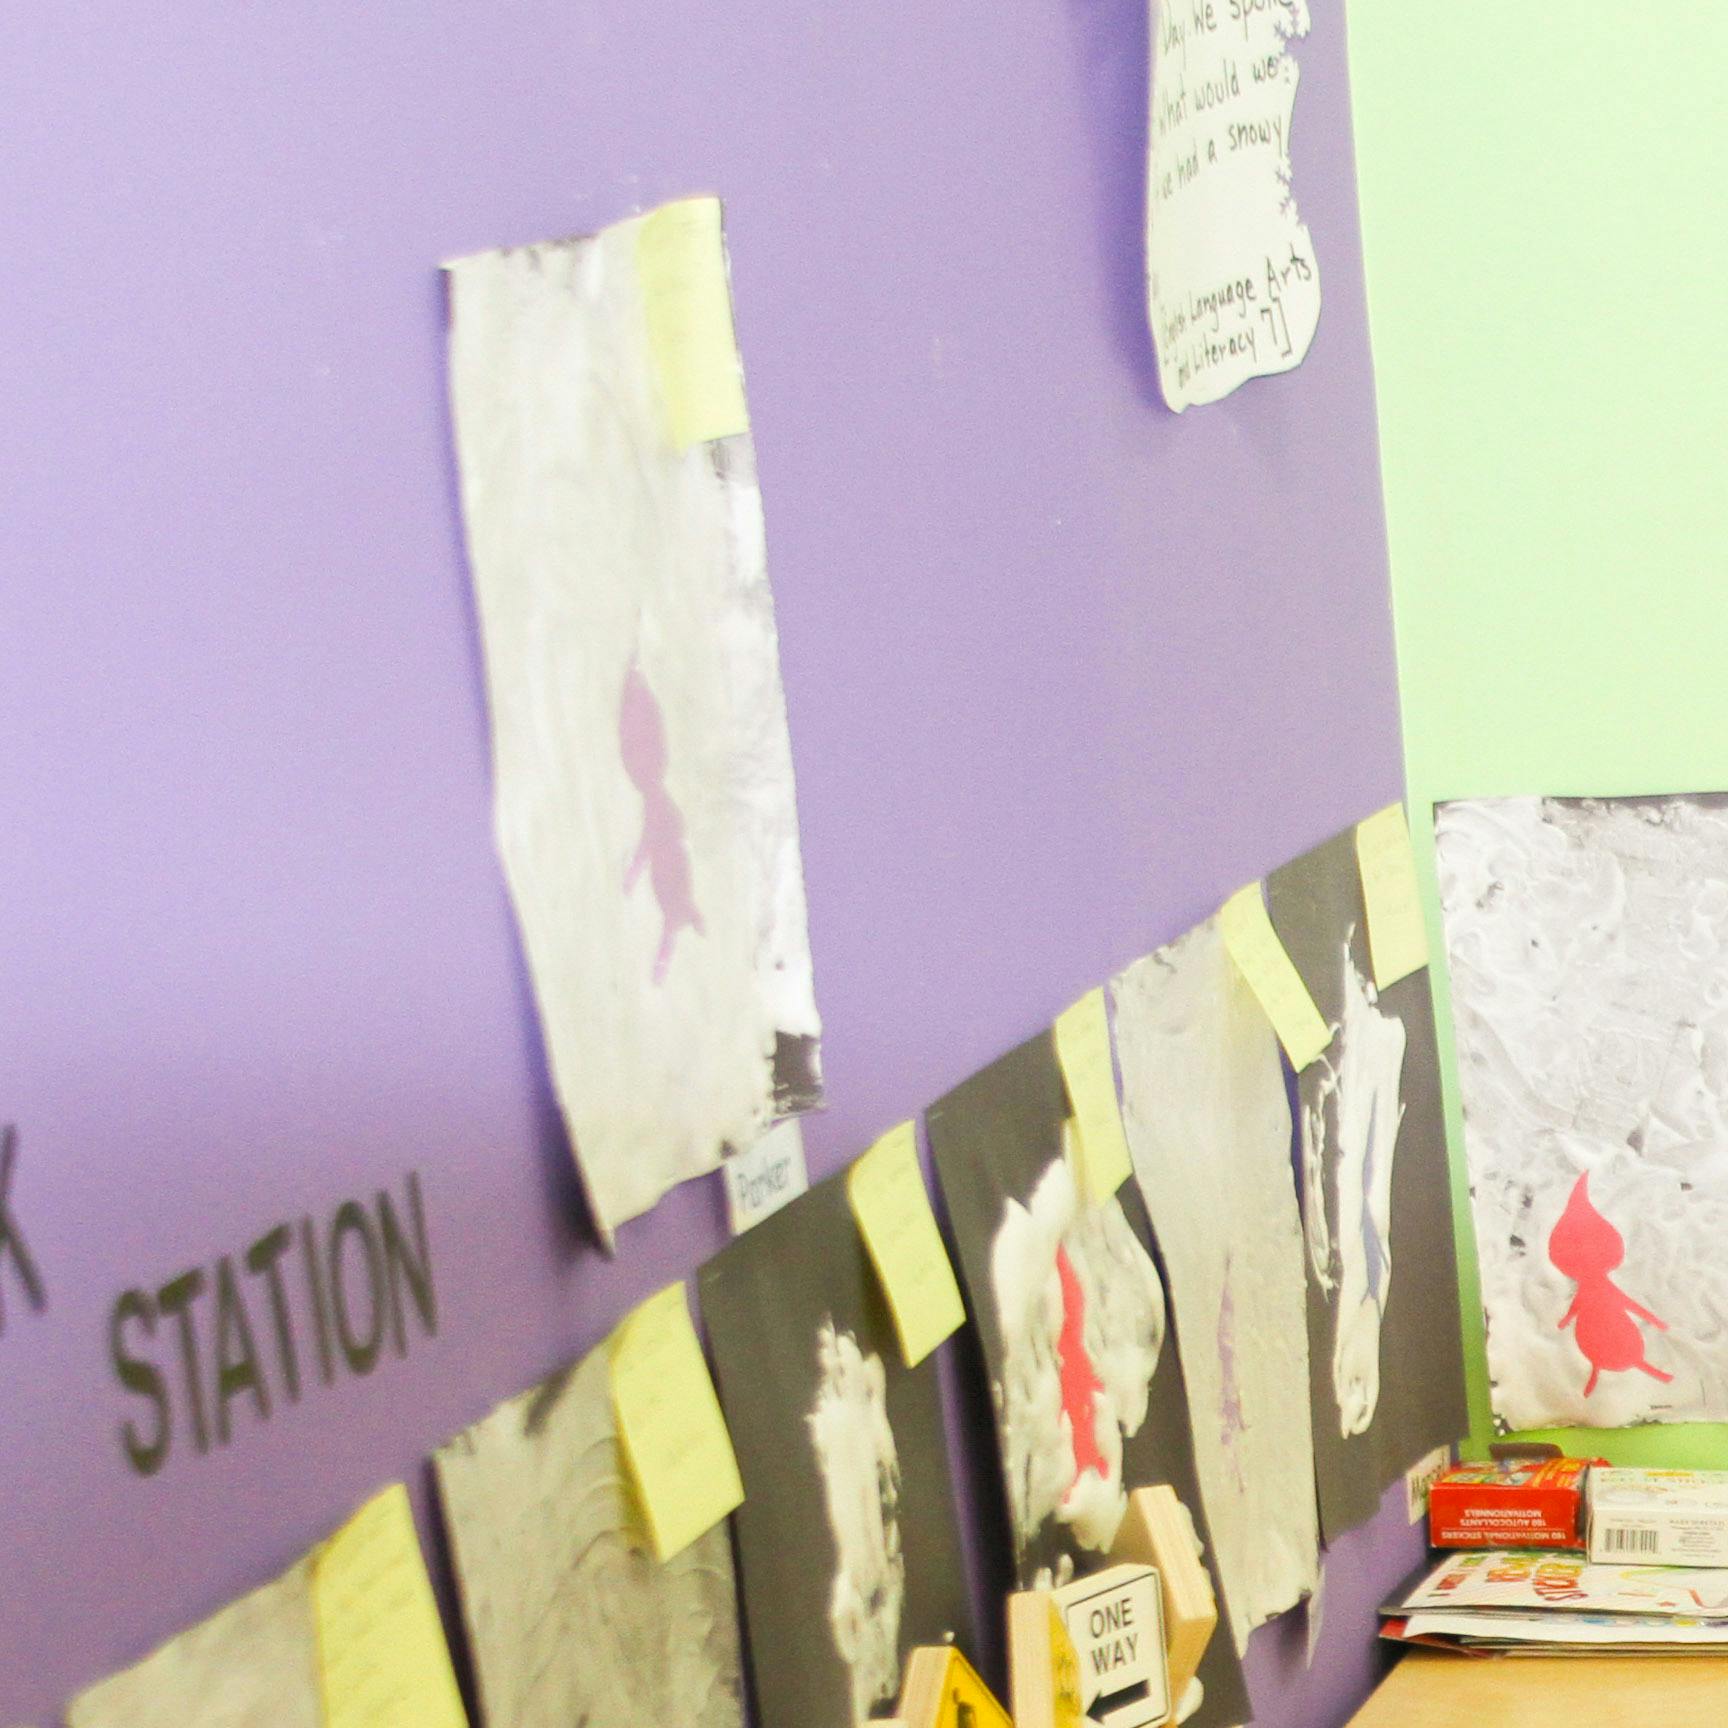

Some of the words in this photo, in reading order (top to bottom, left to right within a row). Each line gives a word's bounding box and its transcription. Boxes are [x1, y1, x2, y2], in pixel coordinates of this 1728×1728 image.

[1194, 58, 1241, 111] would
[1228, 115, 1283, 157] snowy
[1188, 278, 1256, 332] Language
[1266, 242, 1312, 292] Arts
[1193, 327, 1257, 373] Literacy
[110, 1170, 438, 1477] STATION
[1090, 1597, 1135, 1640] ONE
[1091, 1633, 1138, 1676] WAY
